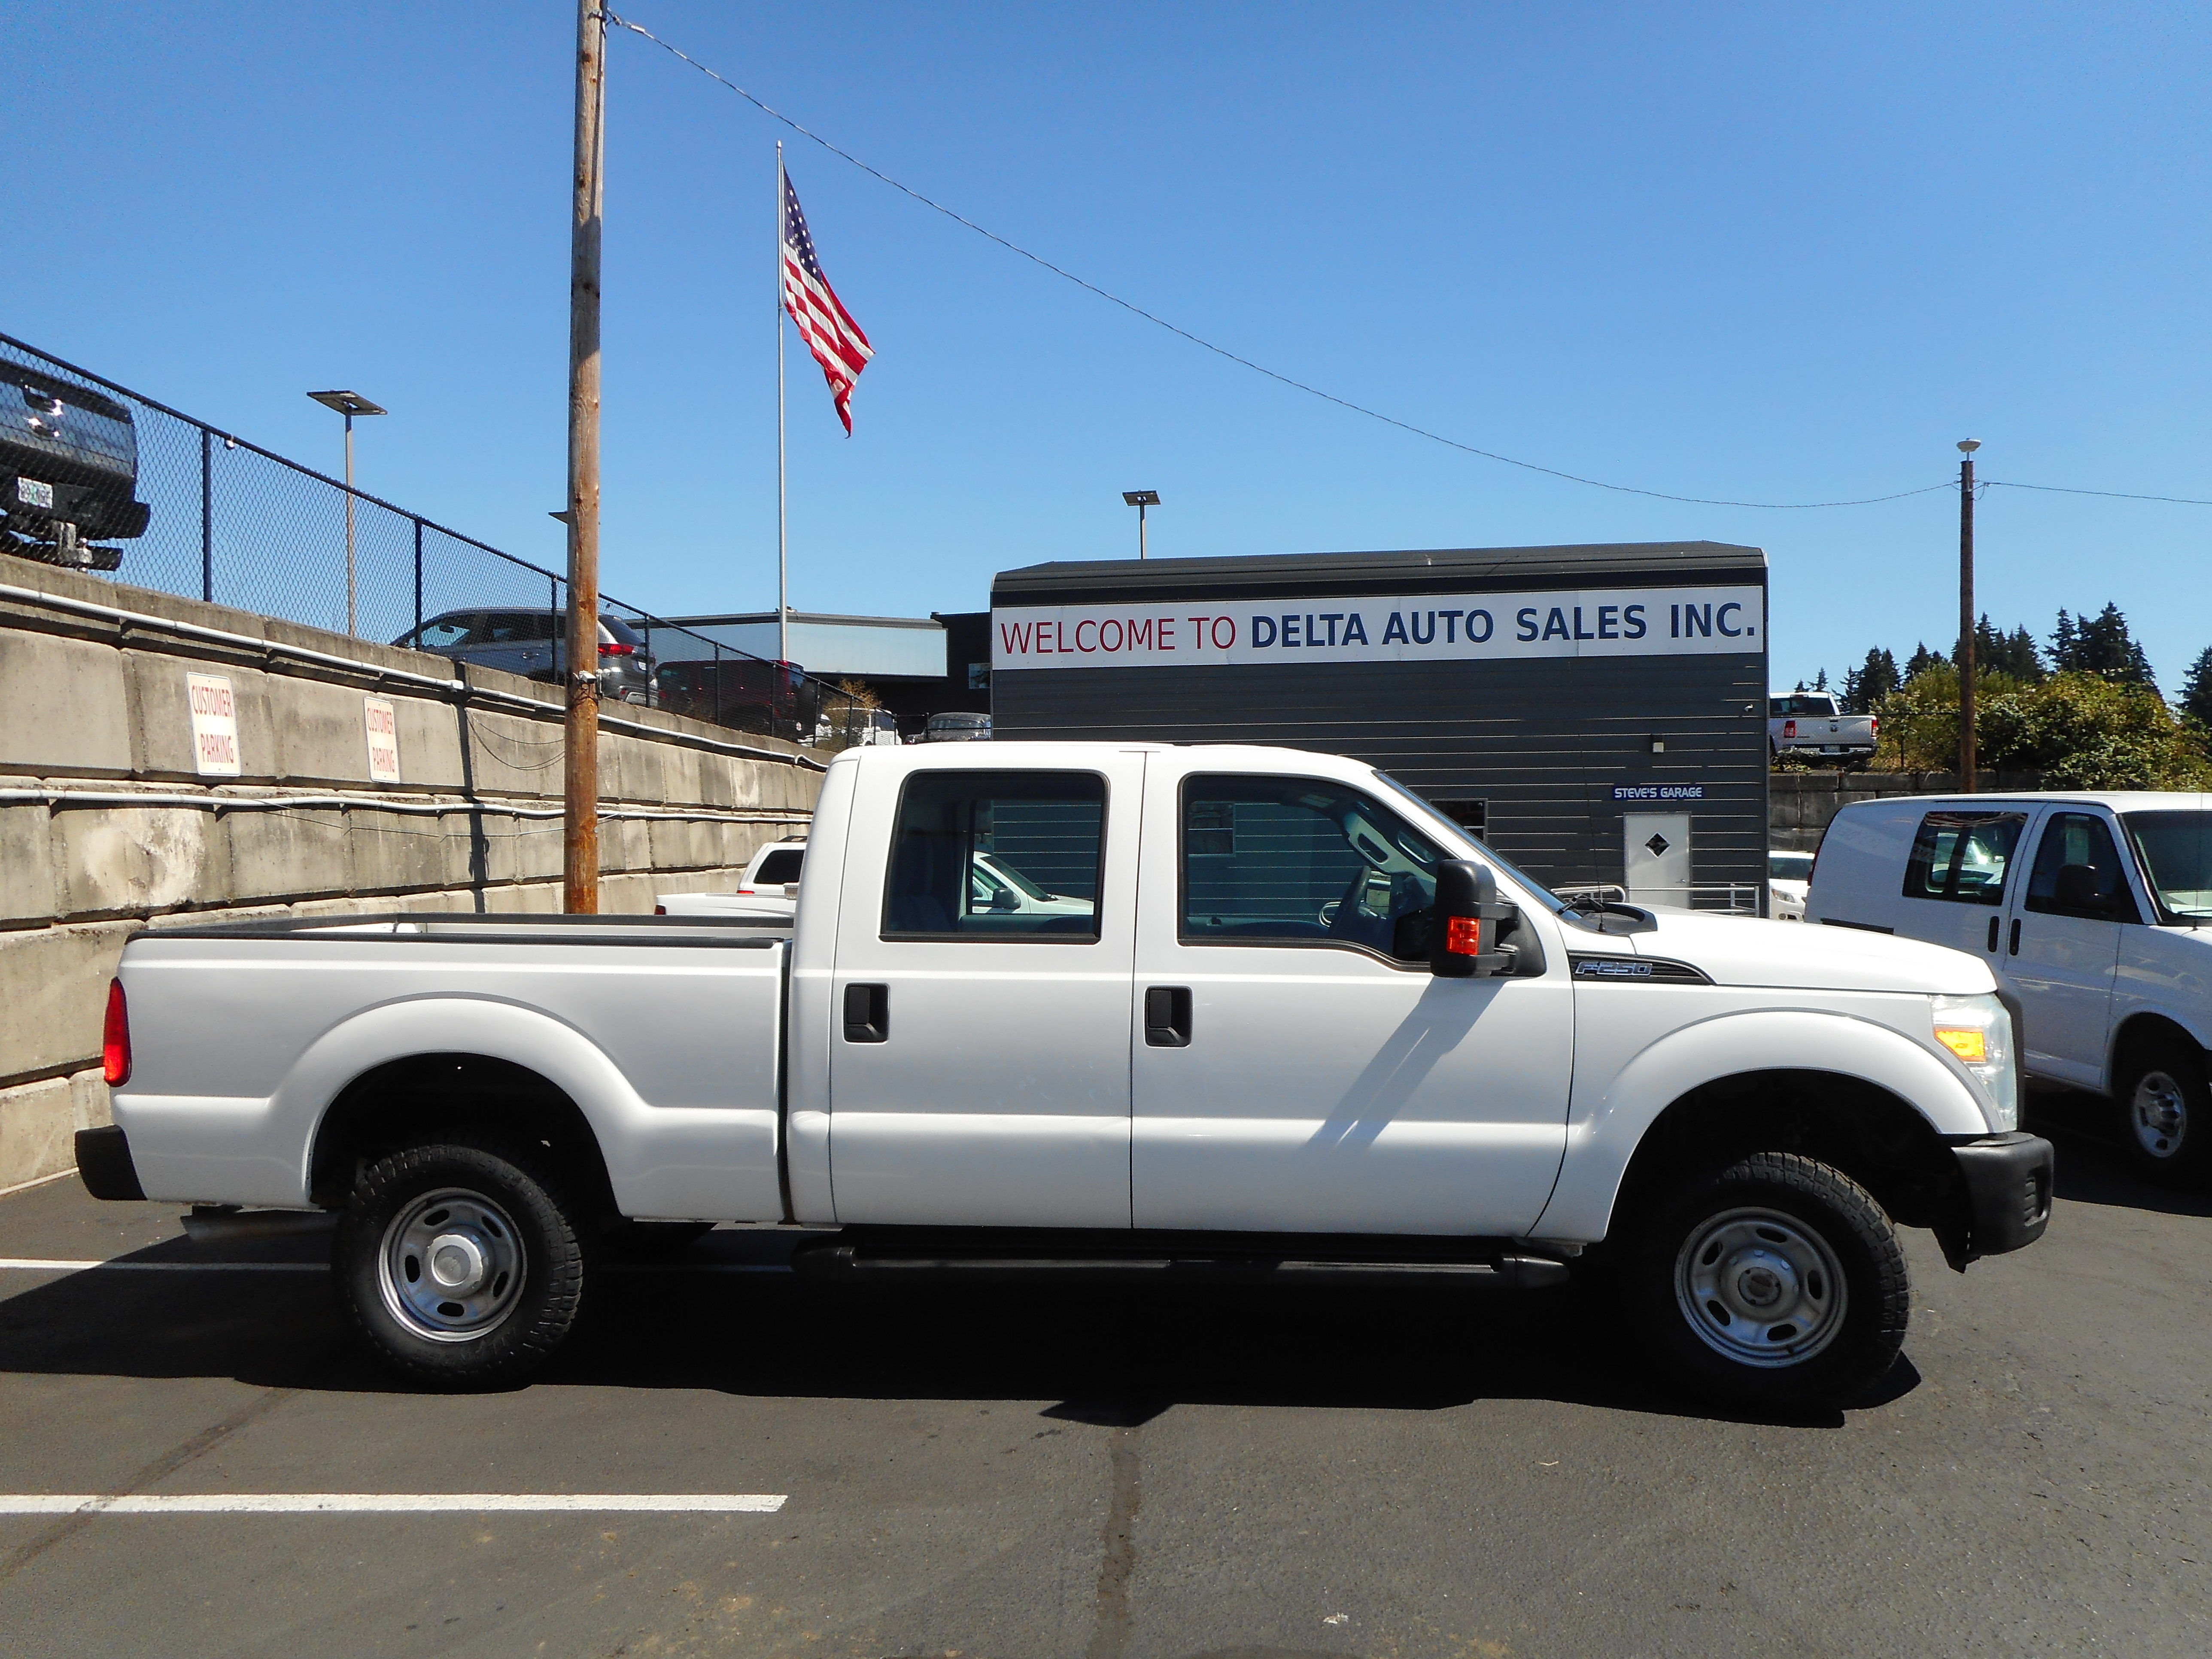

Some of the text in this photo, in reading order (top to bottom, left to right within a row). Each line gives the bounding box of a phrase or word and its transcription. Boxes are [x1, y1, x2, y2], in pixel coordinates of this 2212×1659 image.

[1000, 602, 1755, 654] WELCOME TO DELTA AUTO SALES INC.
[192, 685, 233, 717] CUSTOMER
[367, 708, 393, 735] CUSTOMER
[201, 733, 234, 763] PARKING
[372, 747, 395, 773] PARKING
[1614, 787, 1702, 798] STEVE'S GARAGE
